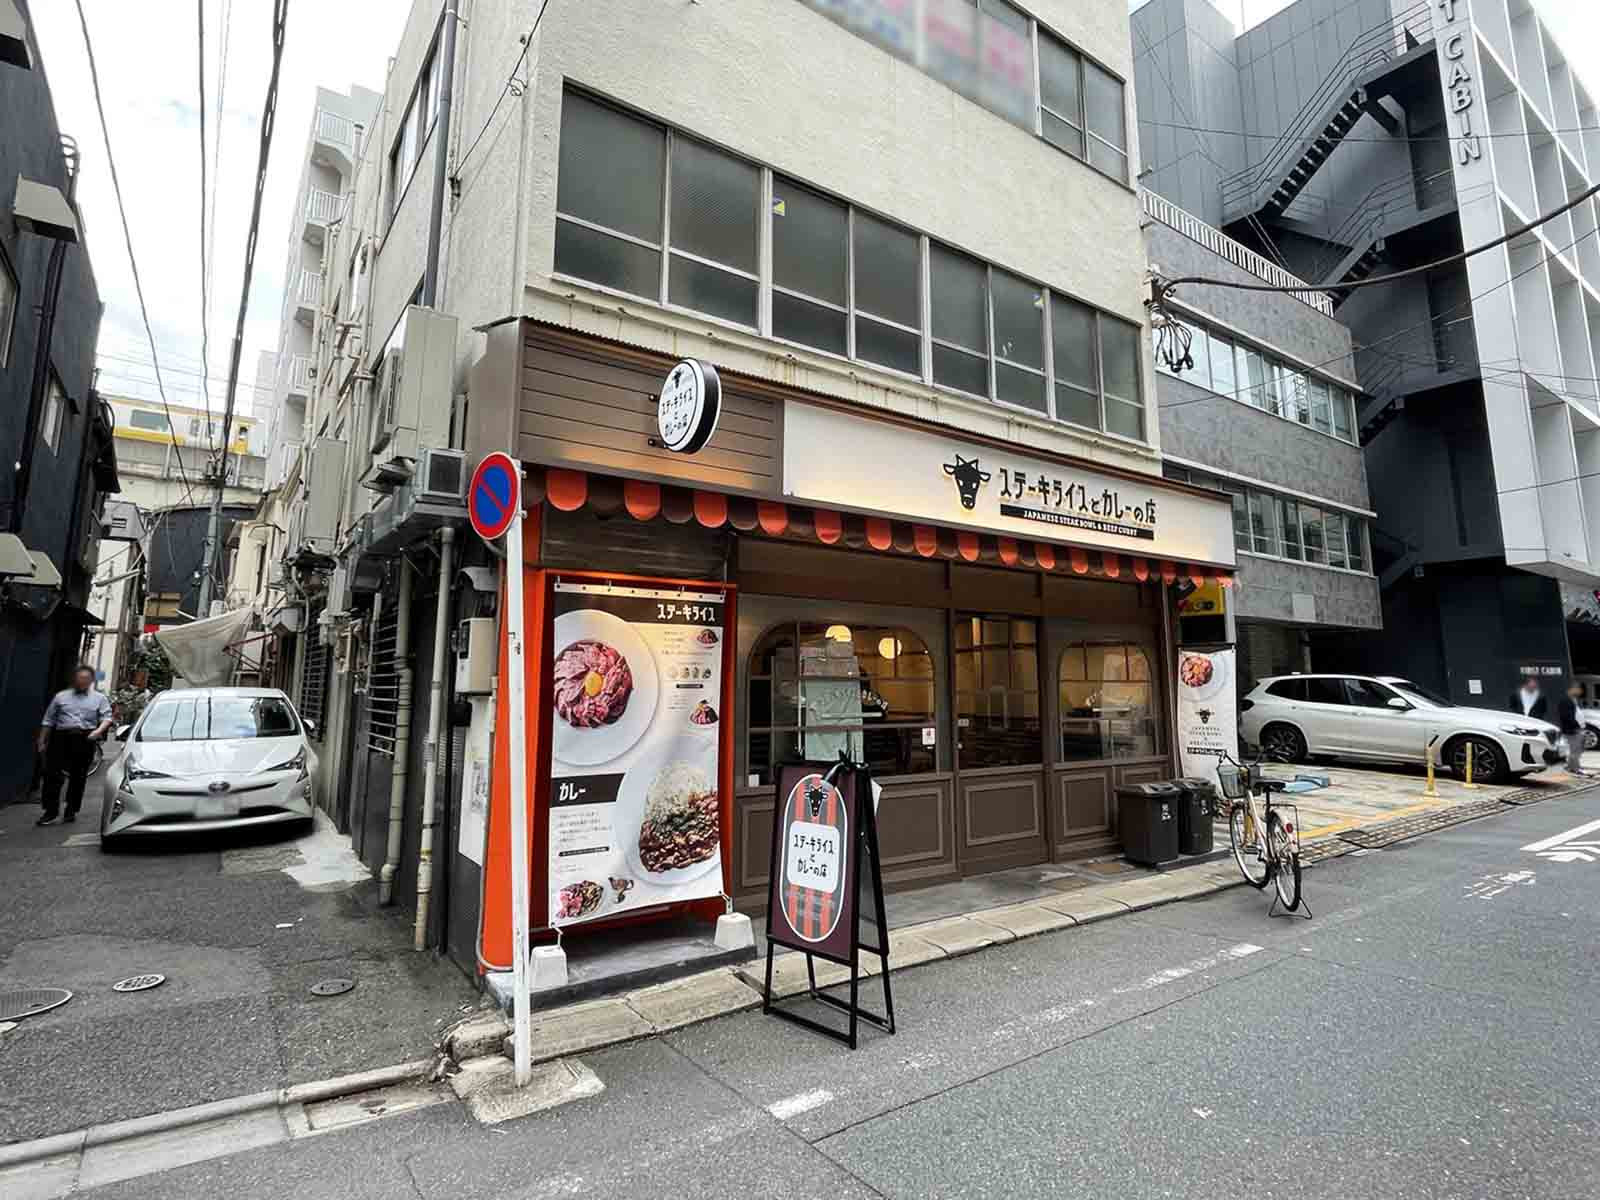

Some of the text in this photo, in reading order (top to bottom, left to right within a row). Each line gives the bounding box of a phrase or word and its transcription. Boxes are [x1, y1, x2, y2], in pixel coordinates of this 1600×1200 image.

[1443, 32, 1481, 165] CABIN
[998, 467, 1157, 525] ステーキライスとカレーの店
[1023, 510, 1059, 524] JAPANESE
[1059, 517, 1080, 528] STEAK
[1080, 519, 1098, 530] BOWL
[1103, 523, 1118, 533] BEEF
[1119, 526, 1137, 537] CURRY
[656, 603, 716, 622] ステーキライス
[559, 782, 586, 801] カレー
[793, 834, 834, 854] ステーキライス
[797, 857, 828, 877] カレーの店
